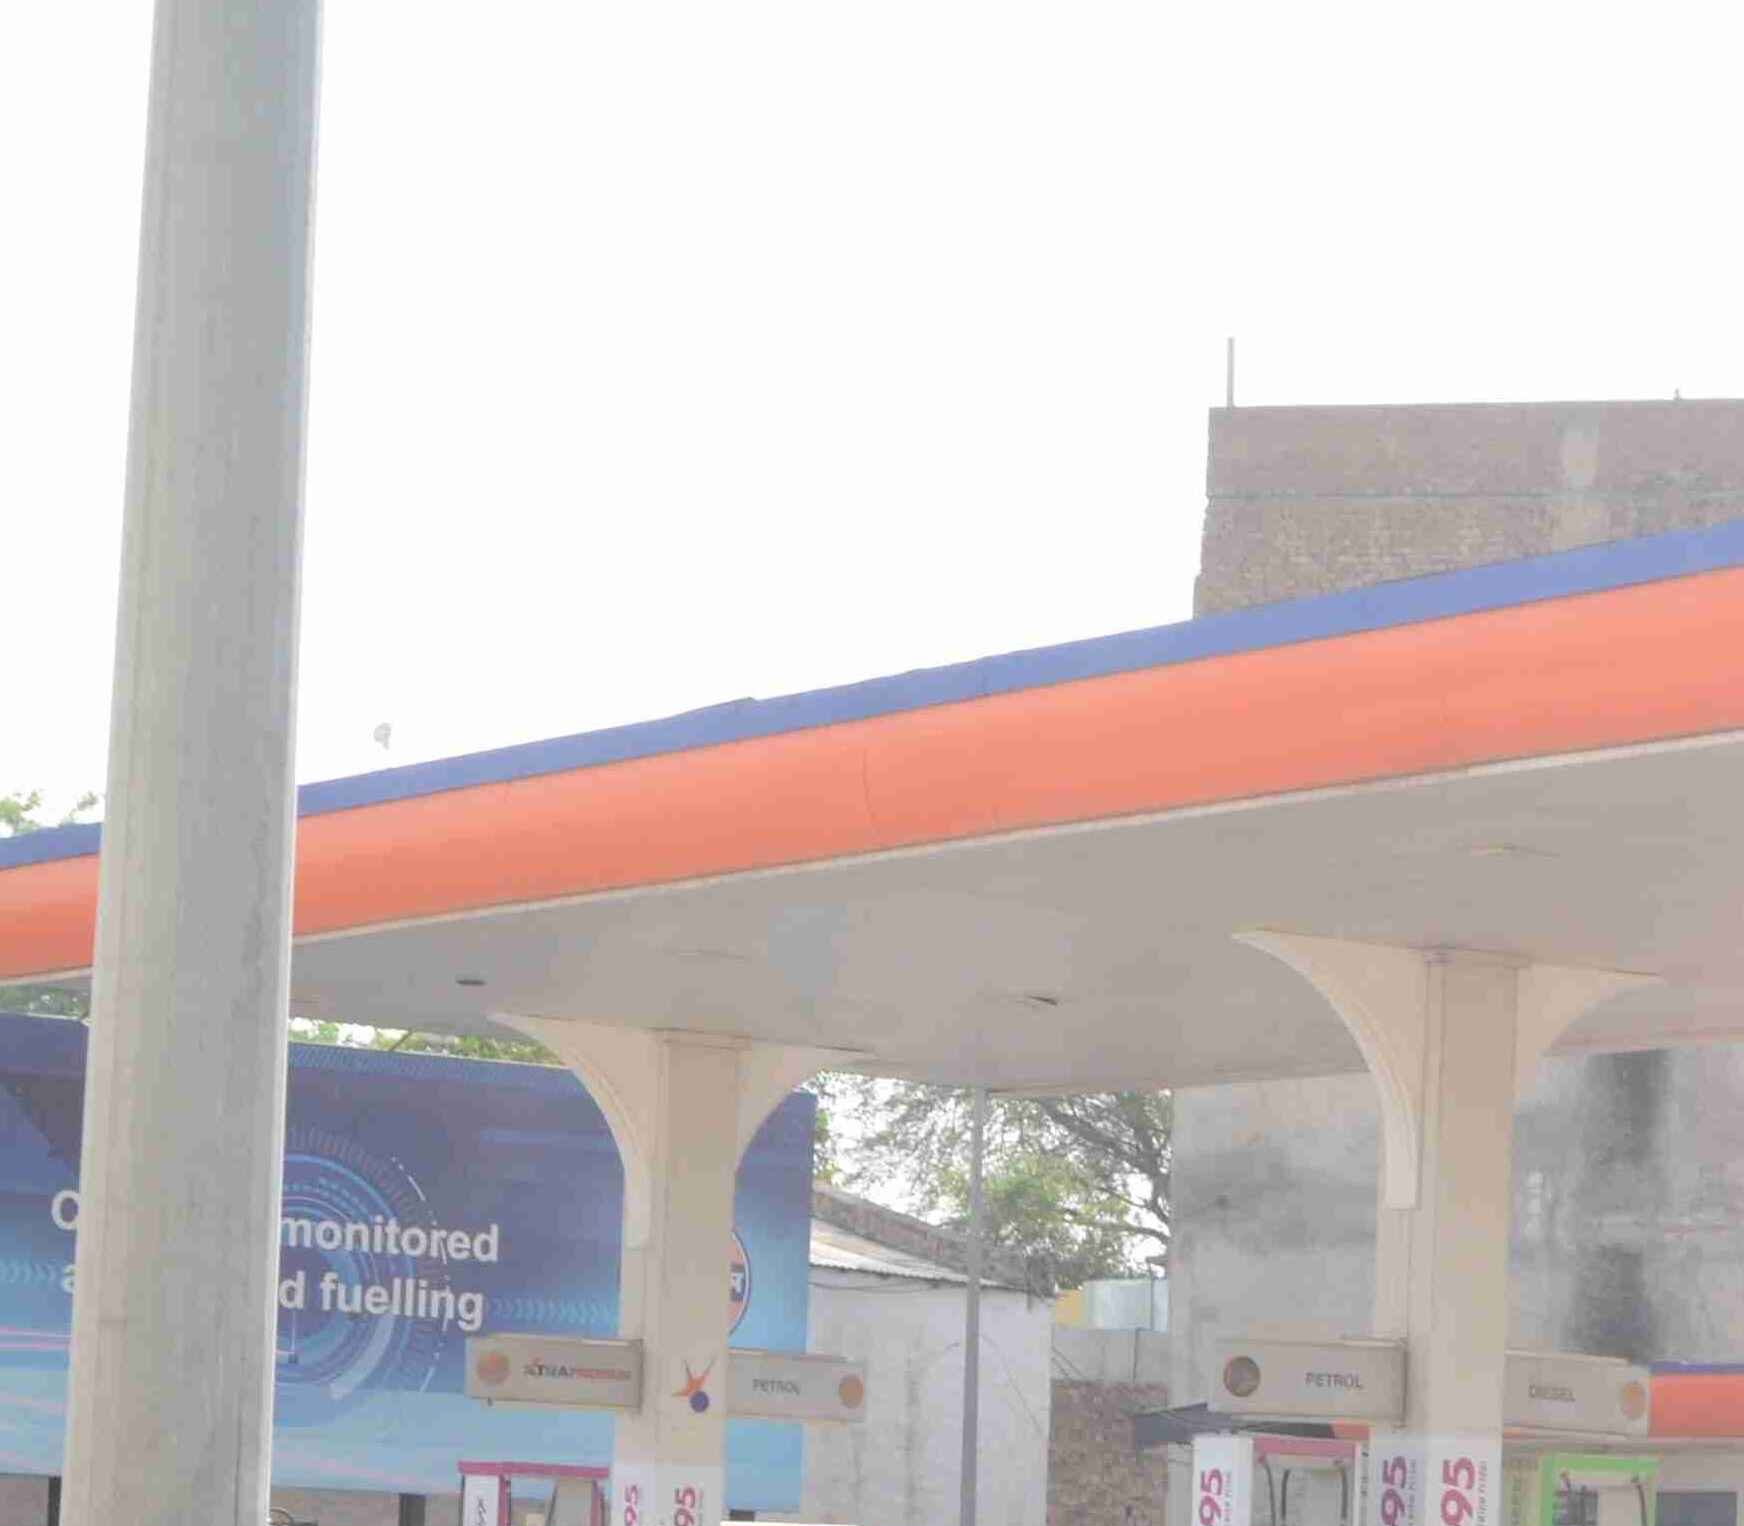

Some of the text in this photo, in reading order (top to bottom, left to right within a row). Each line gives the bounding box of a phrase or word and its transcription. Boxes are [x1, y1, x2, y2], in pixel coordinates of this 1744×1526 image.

[281, 1214, 499, 1263] monitored
[319, 1271, 484, 1332] fuelling
[1304, 1371, 1364, 1390] PETROL
